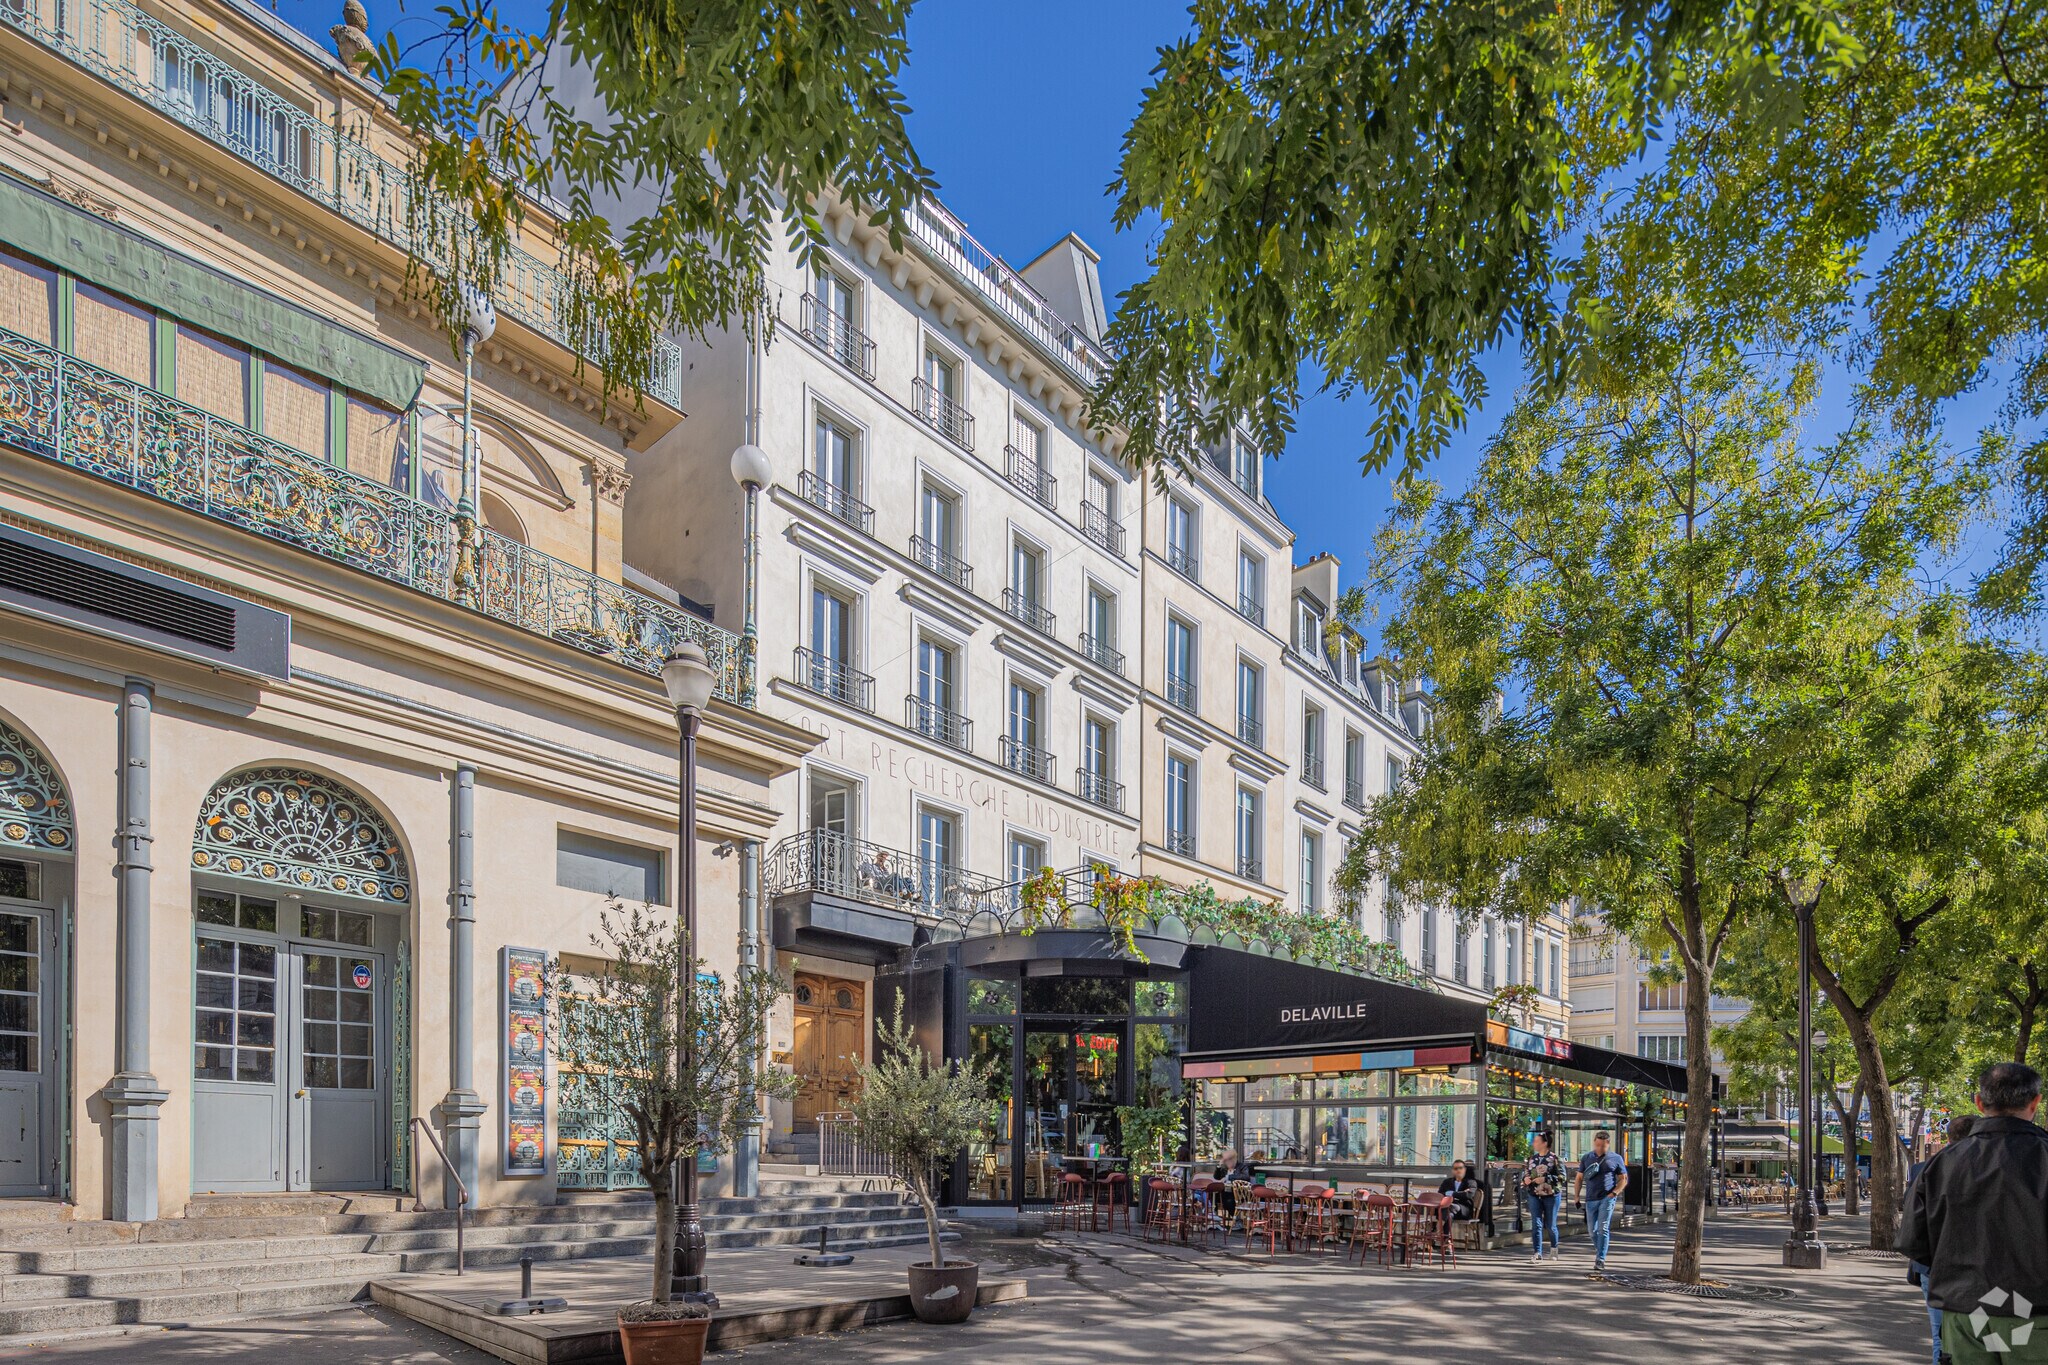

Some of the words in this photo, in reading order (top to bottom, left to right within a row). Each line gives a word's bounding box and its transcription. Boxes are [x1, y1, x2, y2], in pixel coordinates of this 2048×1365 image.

[871, 741, 1009, 817] RECHERCHE
[1026, 793, 1119, 855] INDUSTRIE
[1281, 1003, 1367, 1023] DELAVILLE
